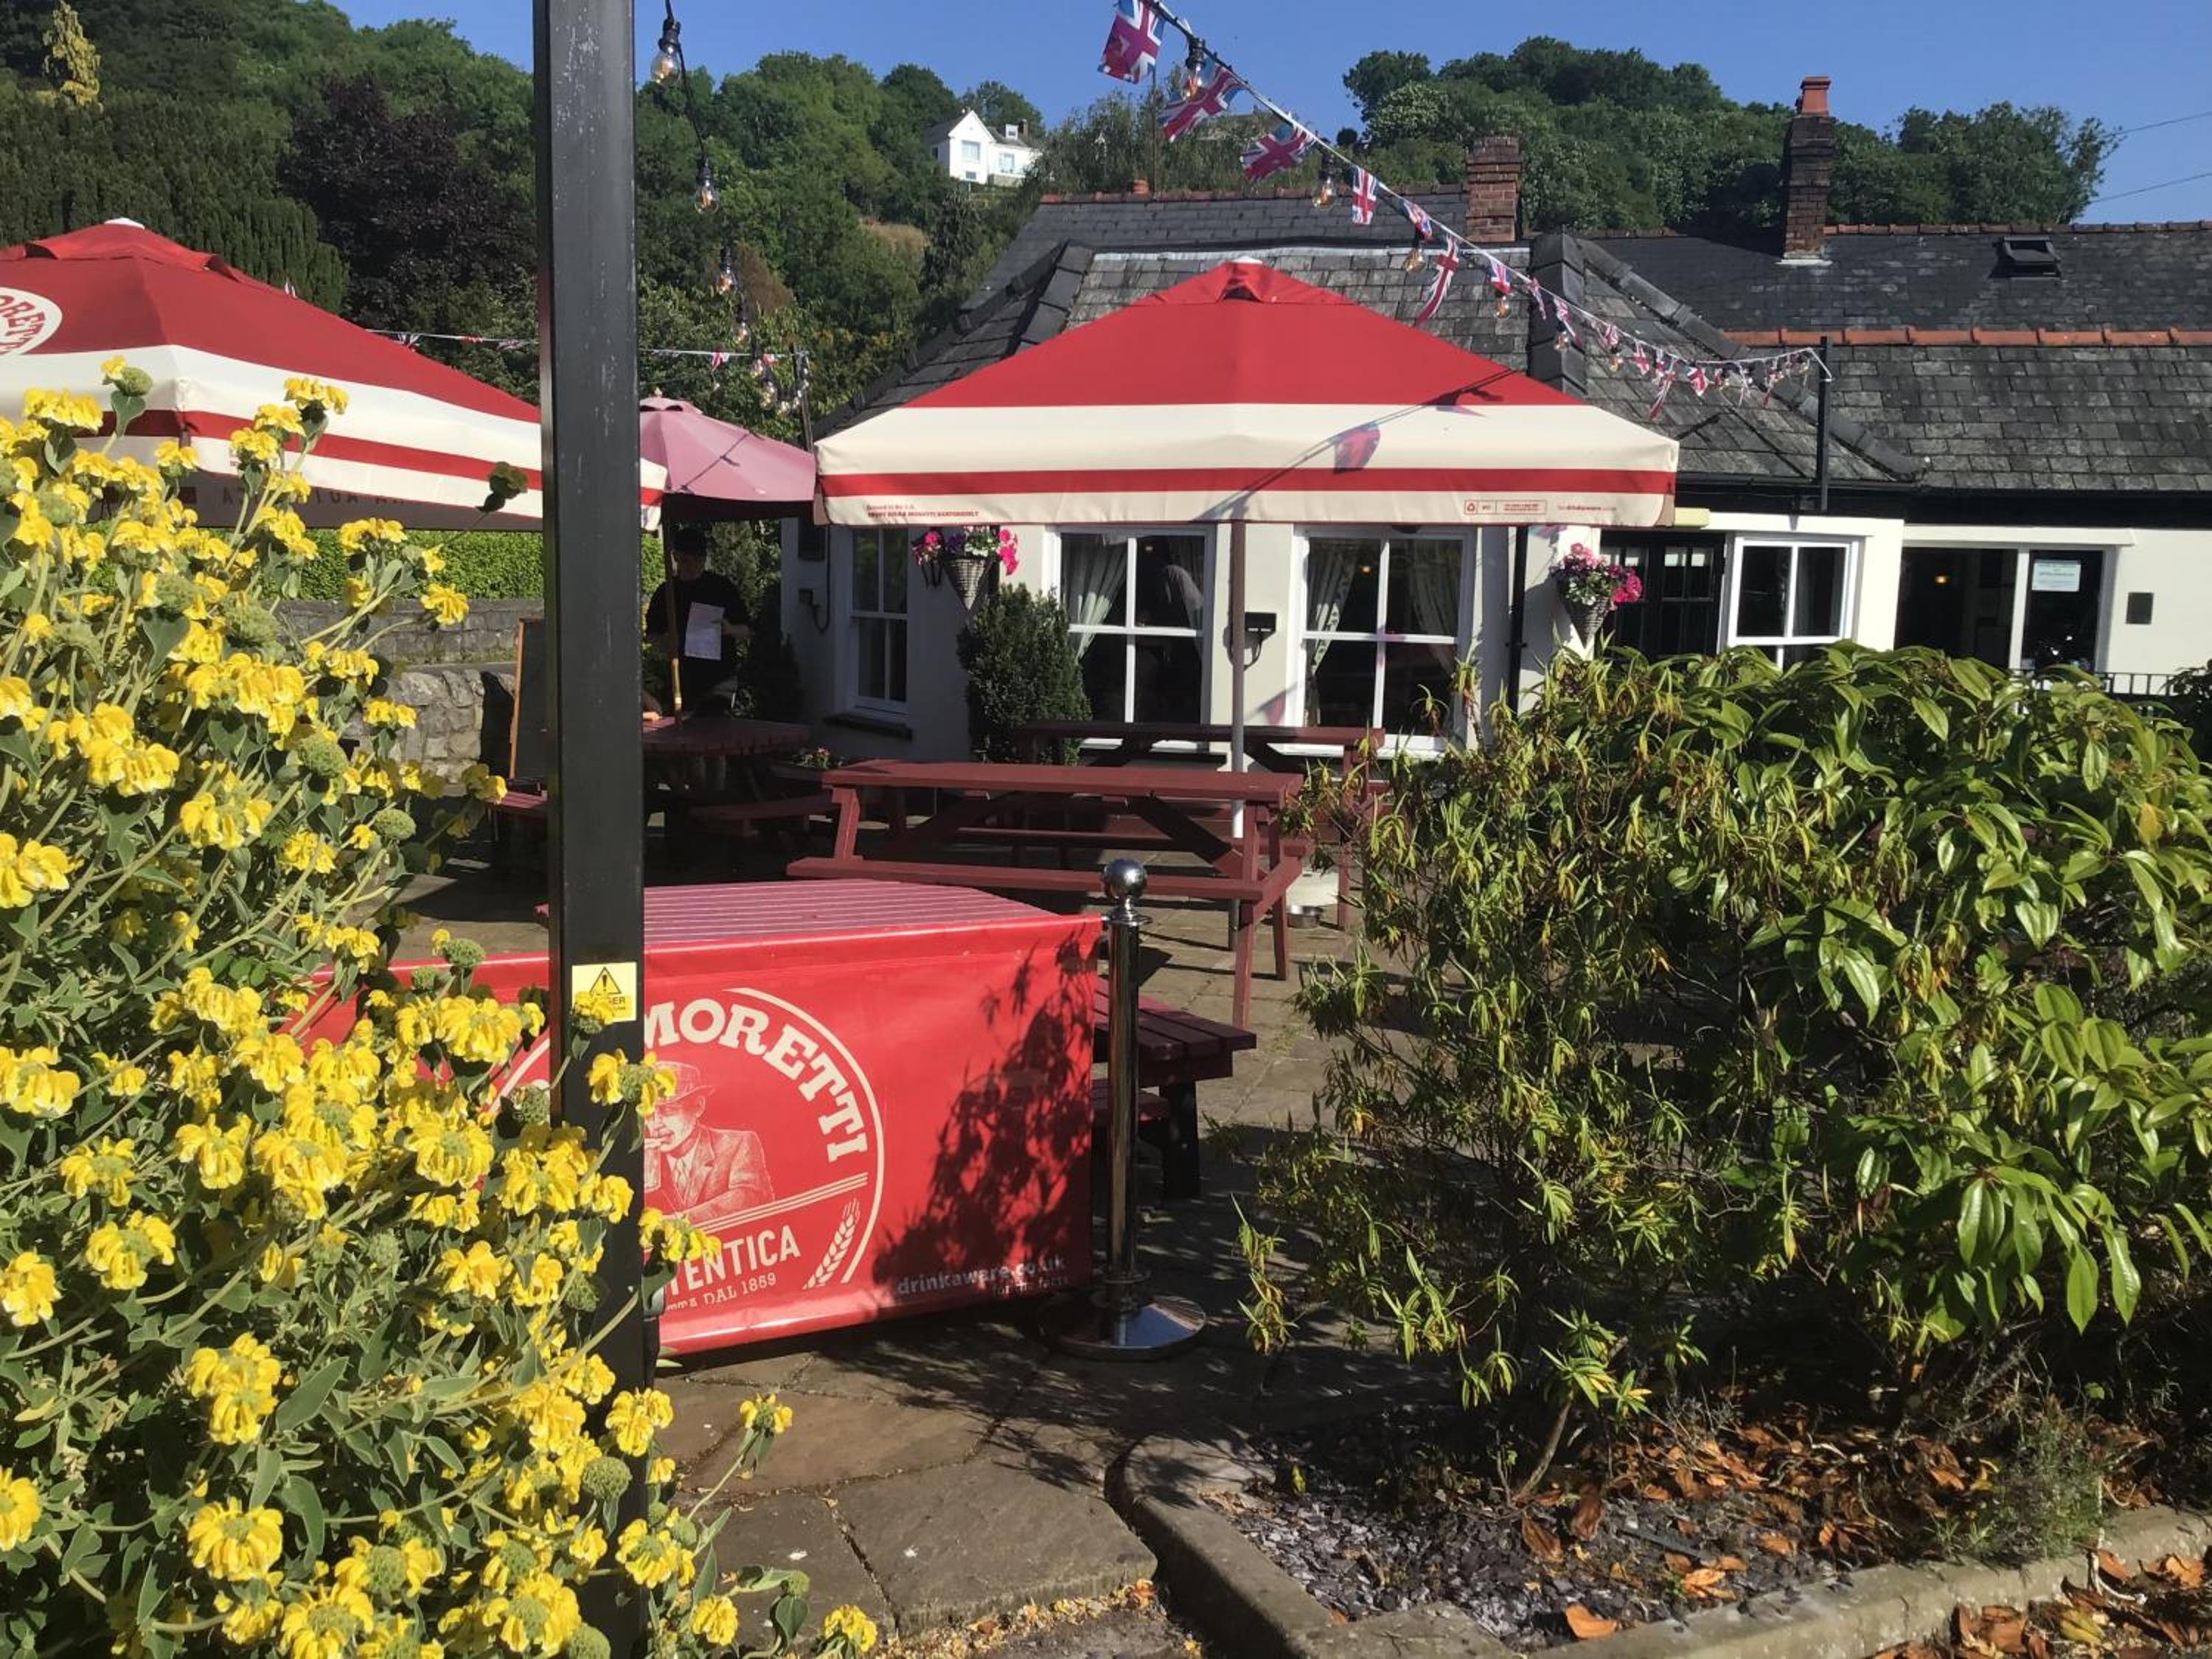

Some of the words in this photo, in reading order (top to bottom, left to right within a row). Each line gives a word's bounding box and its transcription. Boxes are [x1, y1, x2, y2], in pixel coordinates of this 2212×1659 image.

[644, 998, 868, 1164] MORETTI
[703, 1285, 737, 1305] DAL
[896, 1254, 1066, 1295] drinkaware.co.uk
